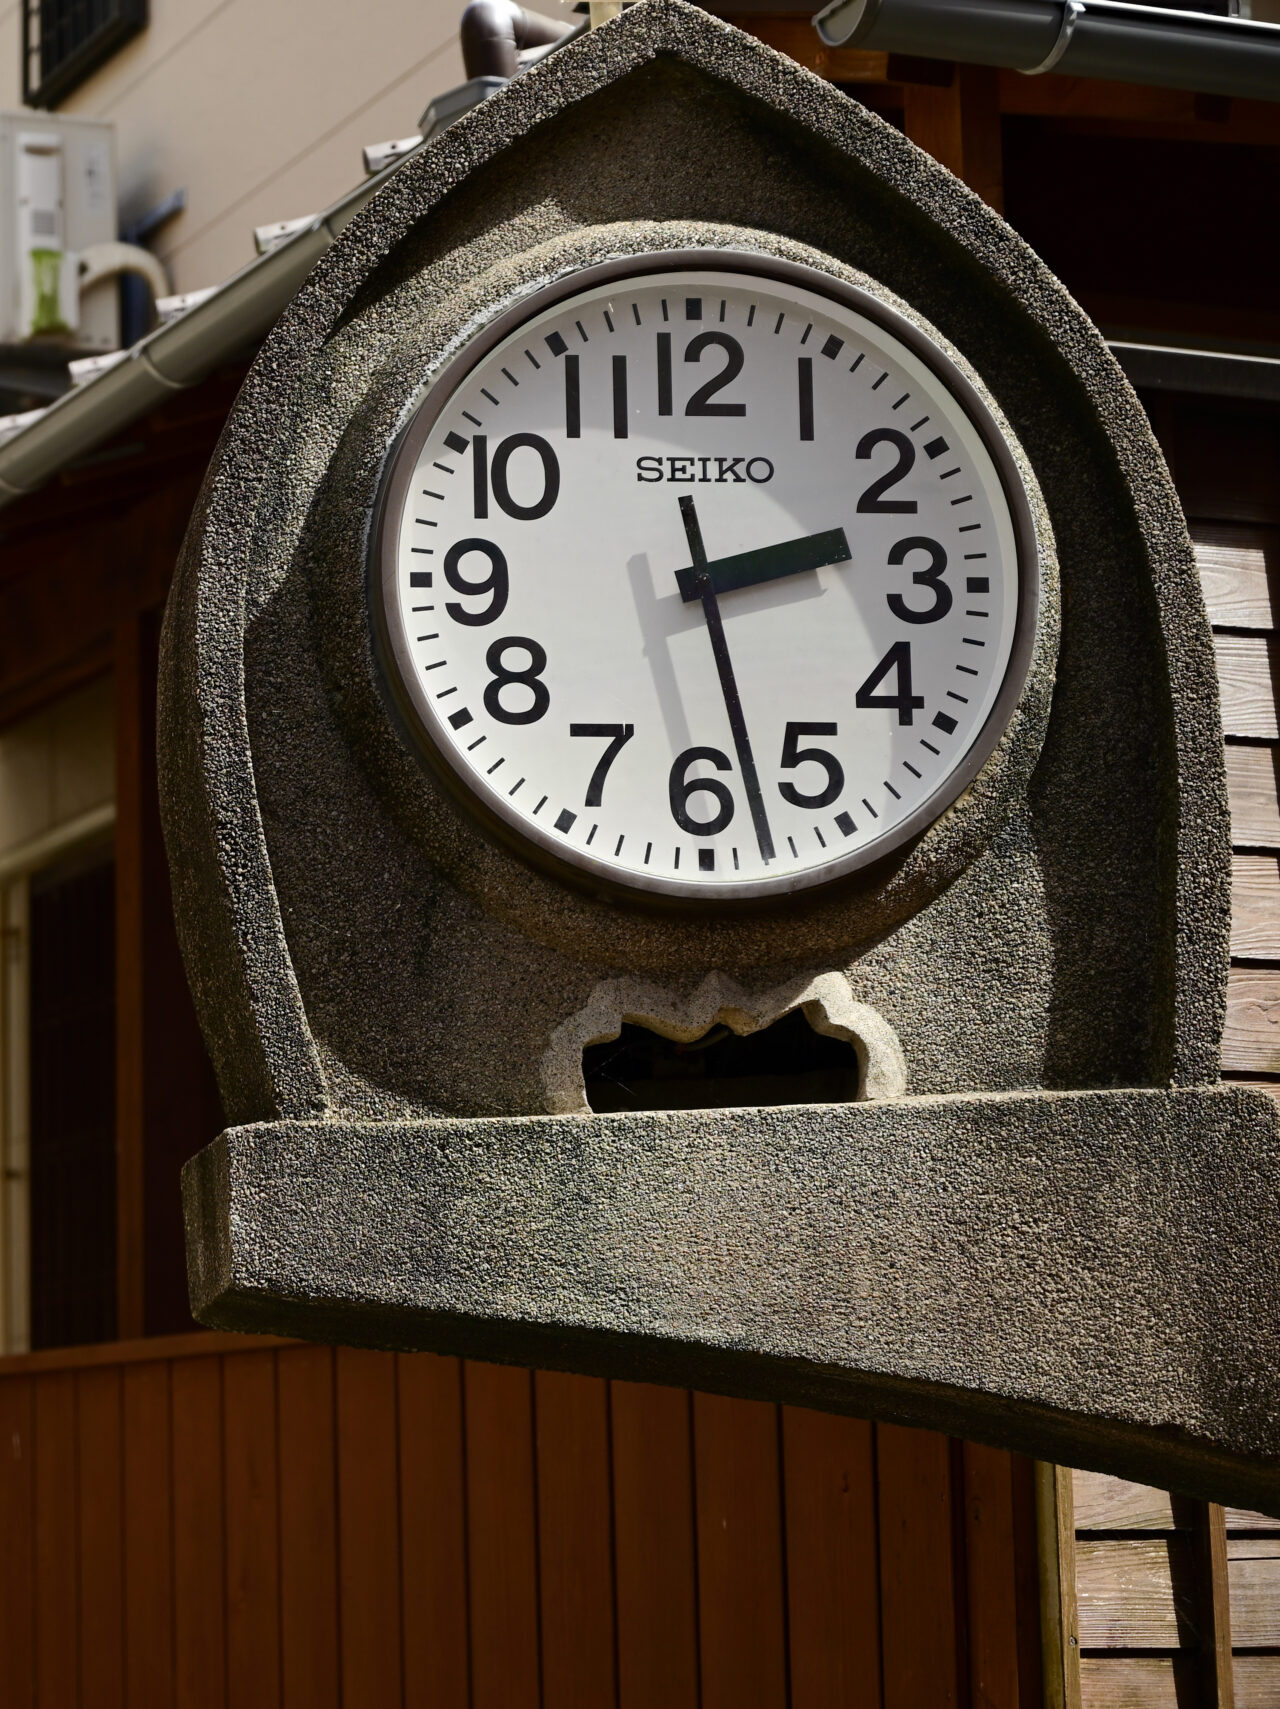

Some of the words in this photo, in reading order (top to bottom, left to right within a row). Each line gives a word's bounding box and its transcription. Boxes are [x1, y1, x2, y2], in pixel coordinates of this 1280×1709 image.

[565, 355, 628, 438] 11
[657, 331, 746, 416] 12
[798, 357, 814, 441] 1
[473, 433, 560, 520] 10
[637, 456, 774, 483] SEIKO
[856, 428, 917, 514] 2
[444, 538, 508, 626] 9
[887, 536, 952, 624] 3
[484, 637, 549, 725] 8
[856, 642, 924, 726] 4
[570, 724, 634, 807] 7
[669, 747, 734, 836] 6
[778, 722, 844, 809] 5
